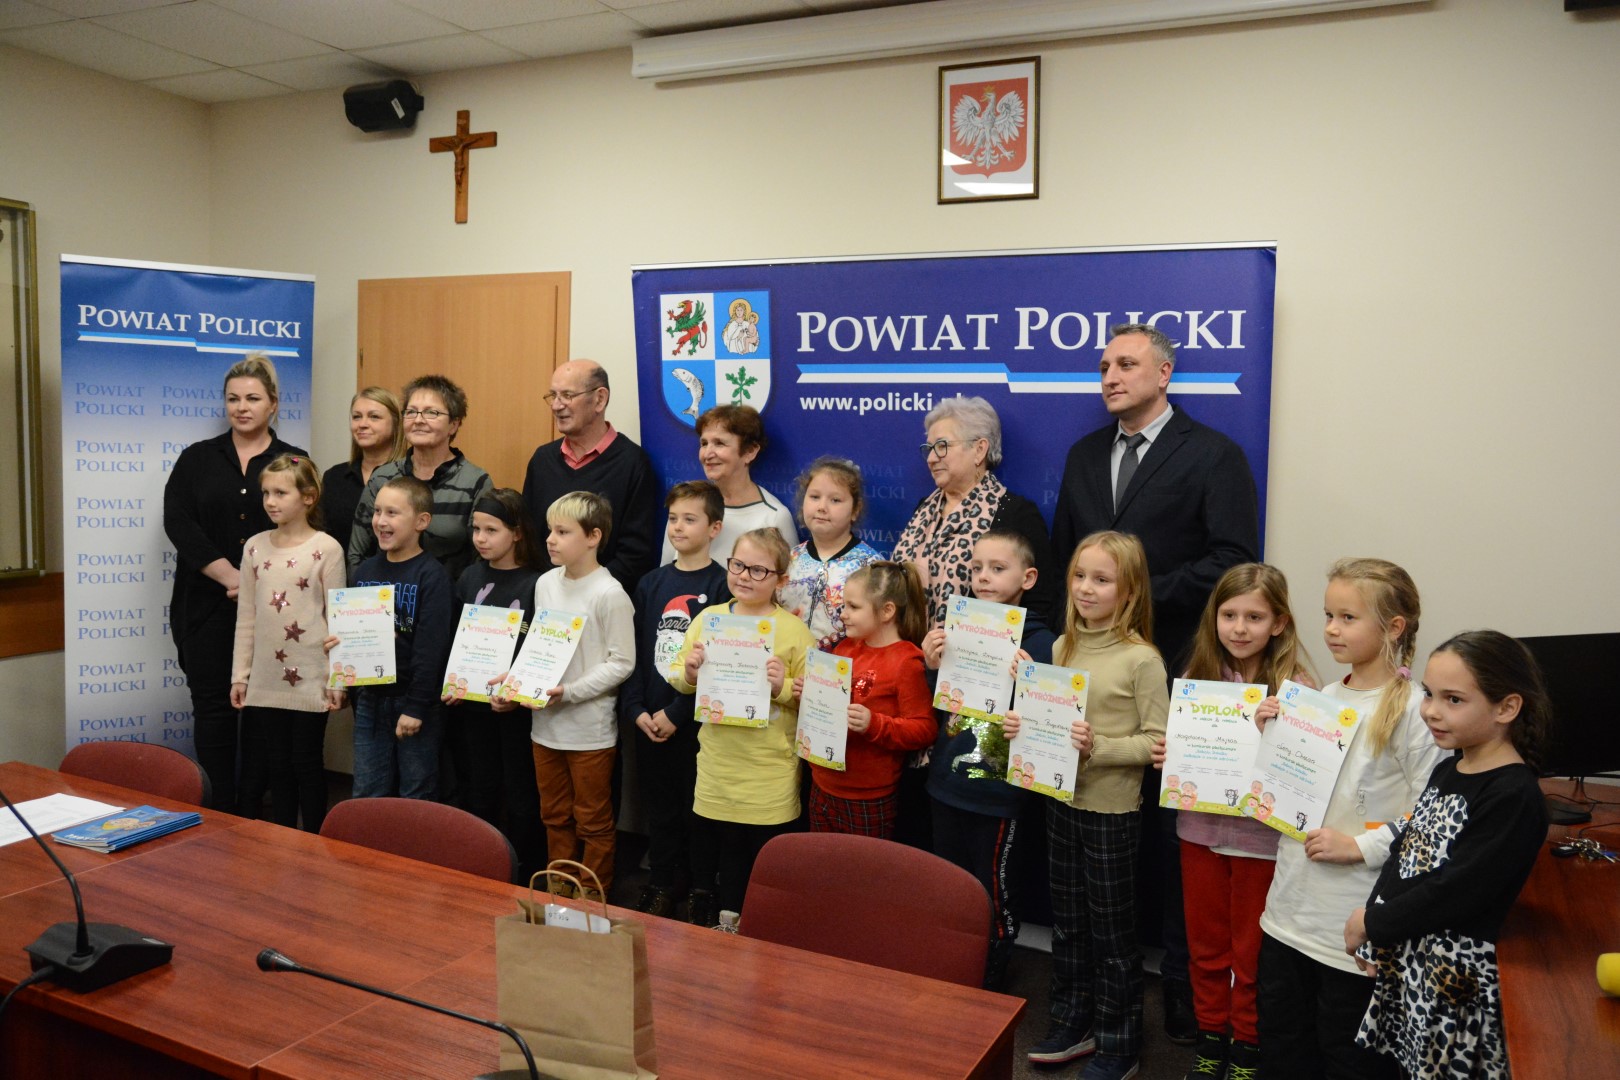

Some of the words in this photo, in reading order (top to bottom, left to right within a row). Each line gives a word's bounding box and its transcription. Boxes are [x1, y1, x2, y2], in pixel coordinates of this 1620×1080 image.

[78, 304, 191, 332] POWIAT
[198, 313, 301, 339] POLICKI
[796, 311, 998, 352] POWIAT
[1191, 703, 1241, 717] DYPLOM
